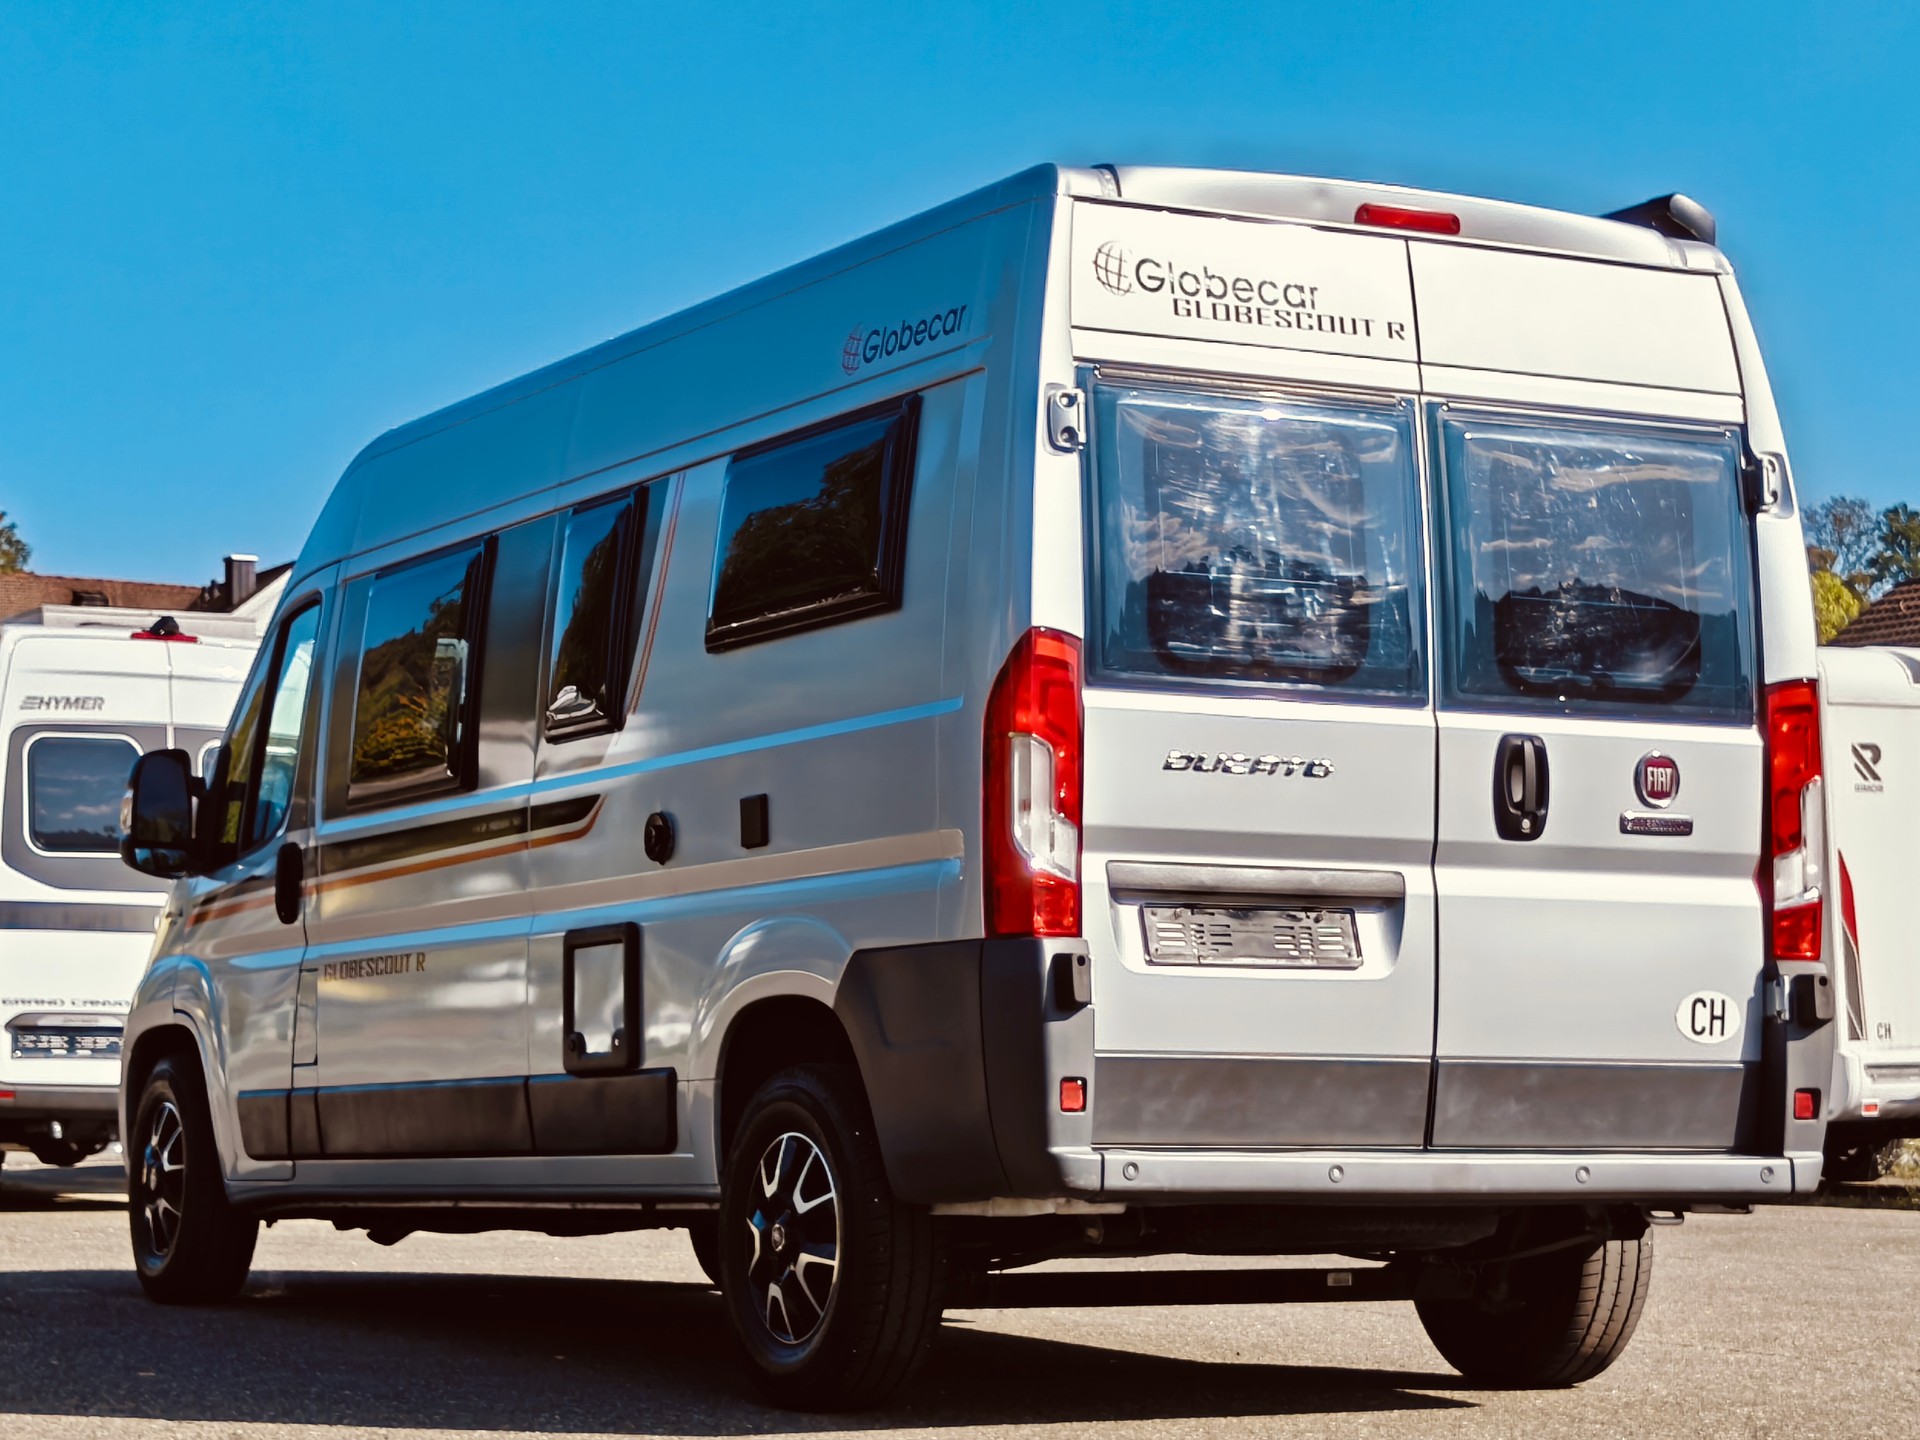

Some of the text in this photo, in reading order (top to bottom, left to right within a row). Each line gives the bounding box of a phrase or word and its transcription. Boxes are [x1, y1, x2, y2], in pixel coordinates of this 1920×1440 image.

[1135, 257, 1319, 311] Globecar
[862, 303, 968, 365] Globecar
[1172, 297, 1406, 341] GLOBESCOUT R
[37, 695, 106, 711] HYMER
[1162, 749, 1336, 779] DUCATO
[1646, 765, 1674, 794] FIAT
[323, 951, 427, 983] GLOBESCOUT R
[1690, 997, 1726, 1037] CH
[1876, 1022, 1892, 1039] CH
